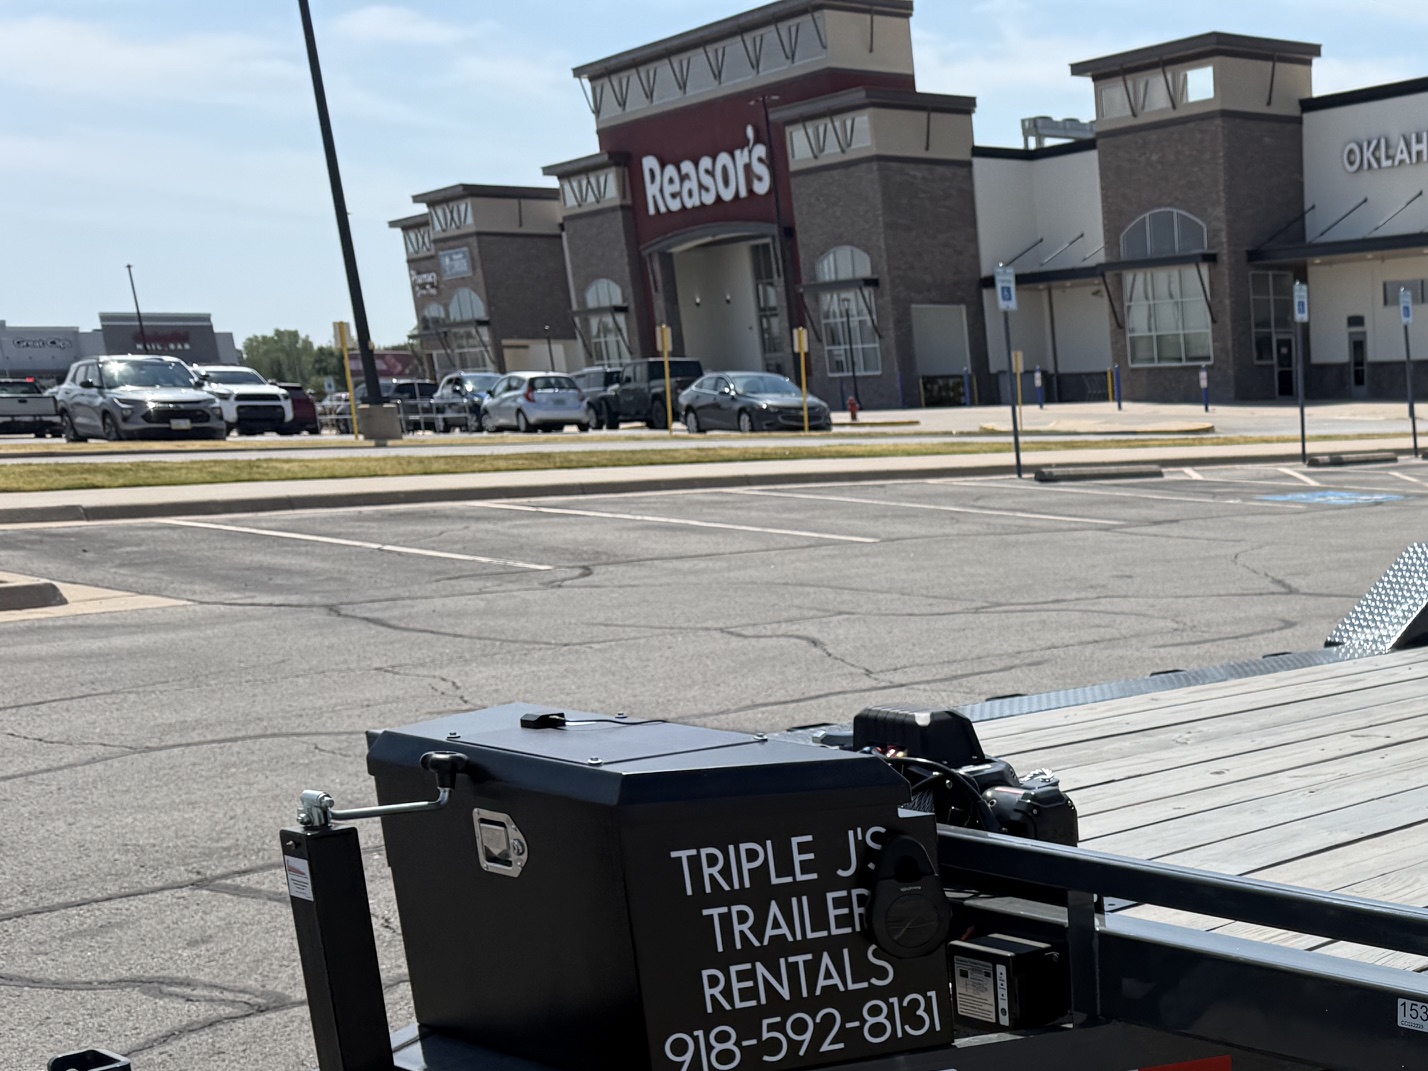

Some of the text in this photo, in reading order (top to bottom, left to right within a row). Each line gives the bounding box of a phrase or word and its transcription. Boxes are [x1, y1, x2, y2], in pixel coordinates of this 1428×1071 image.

[641, 124, 771, 216] Reasor's
[670, 826, 887, 896] TRIPLE J'S
[701, 944, 895, 1014] RENTALS
